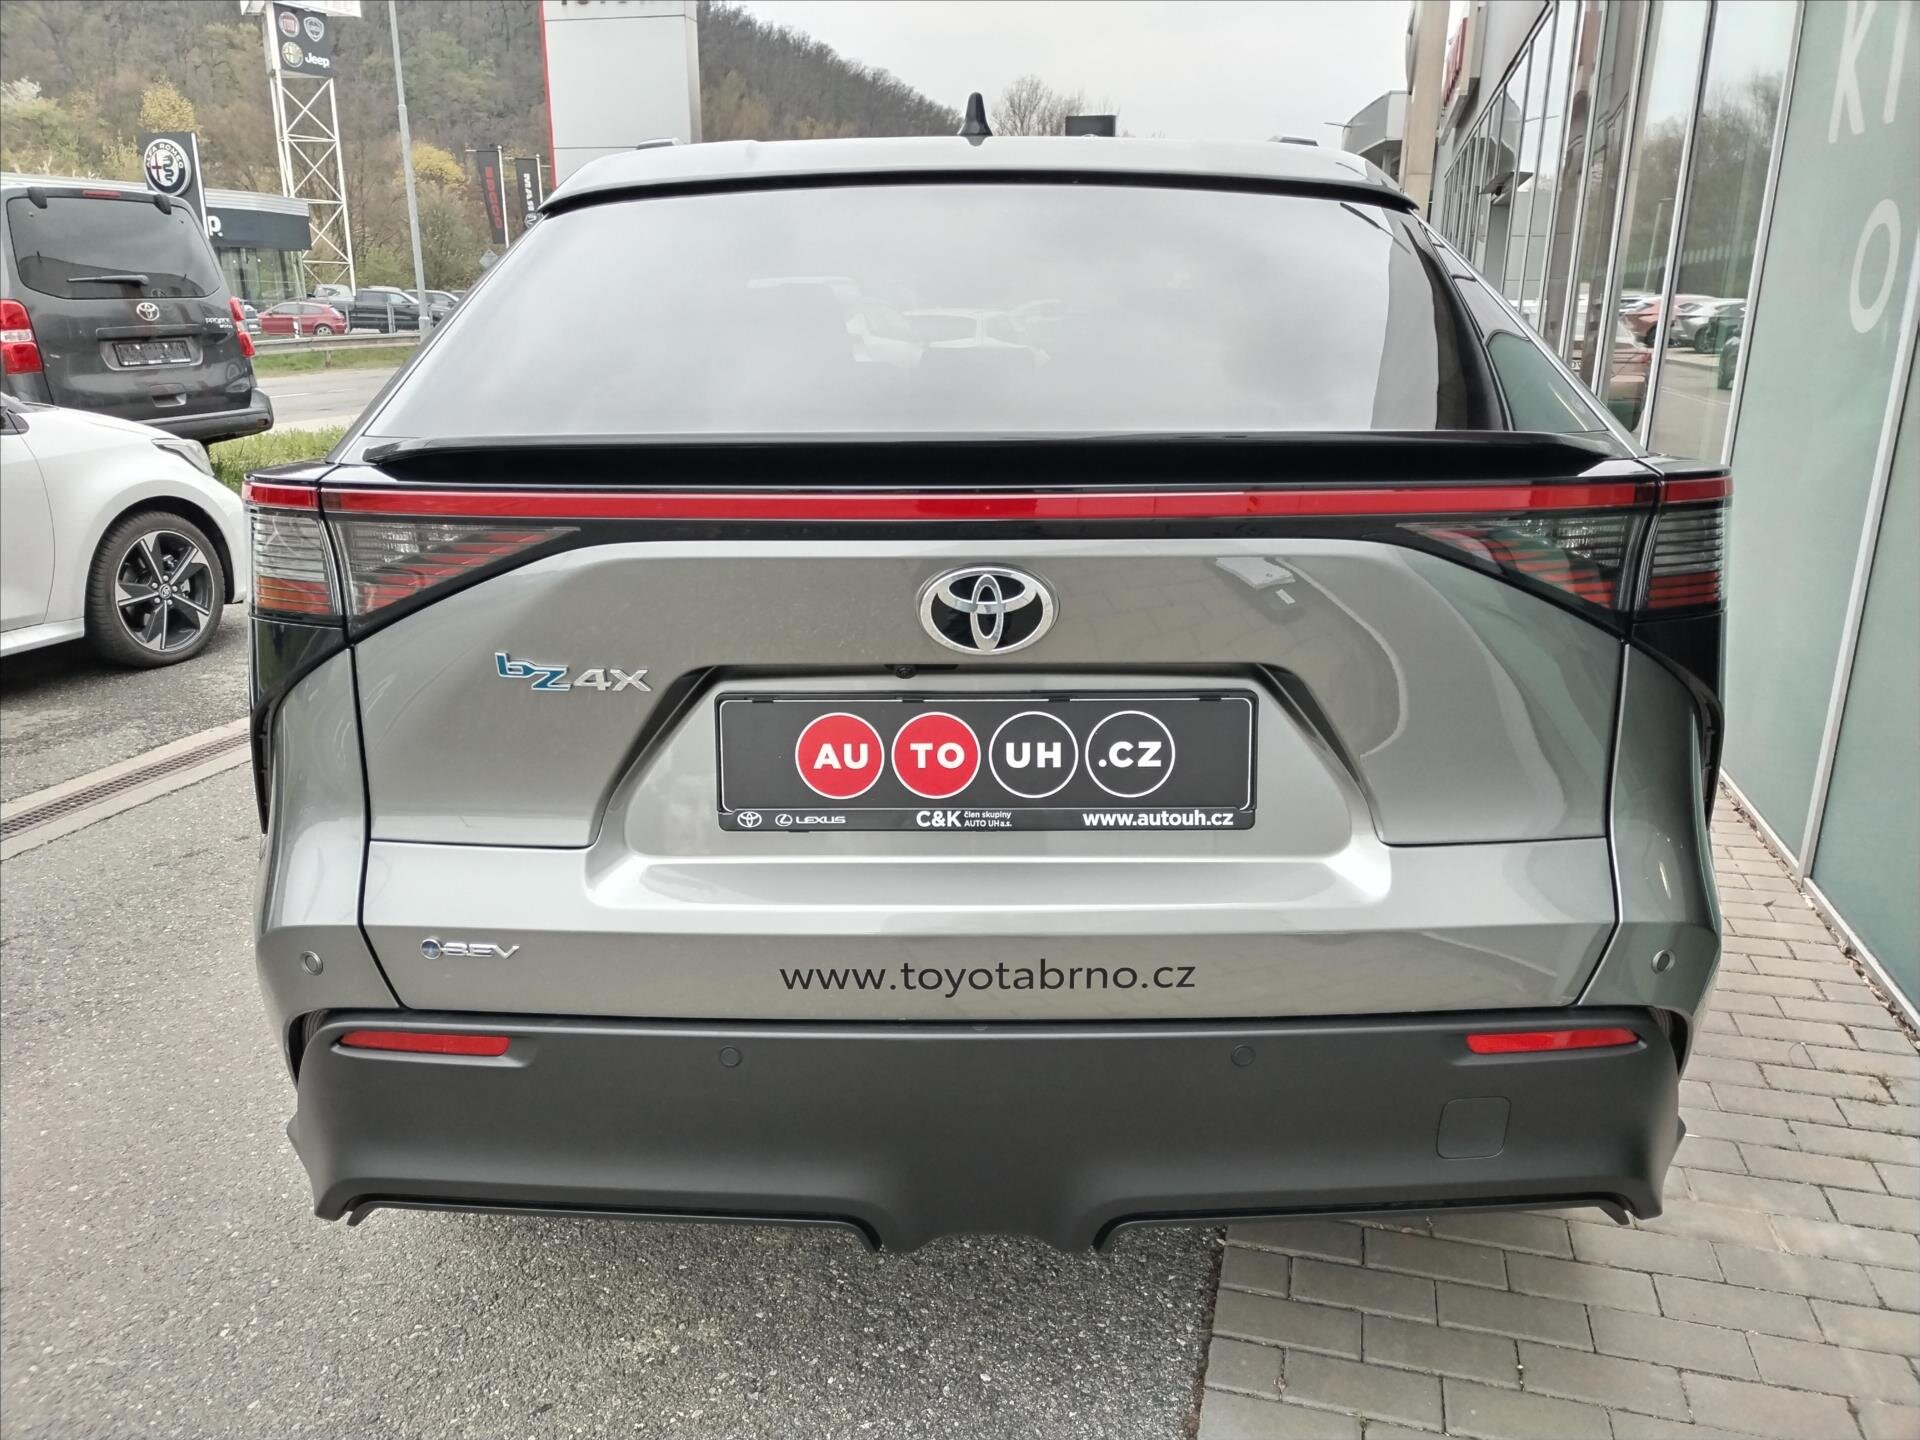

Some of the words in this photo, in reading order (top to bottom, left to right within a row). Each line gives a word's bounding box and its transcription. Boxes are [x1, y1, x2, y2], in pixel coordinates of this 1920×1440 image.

[305, 52, 329, 68] Jeep
[159, 143, 184, 168] ROMEO
[813, 743, 869, 769] AU
[910, 743, 965, 769] TO
[1005, 742, 1062, 768] UH
[796, 815, 847, 825] LEXUS
[916, 810, 962, 828] C&K
[964, 820, 987, 828] AUTO
[988, 820, 1000, 828] UH
[1082, 811, 1234, 828] www.autouh.cz
[780, 958, 1196, 998] www.toyotabrno.cz
